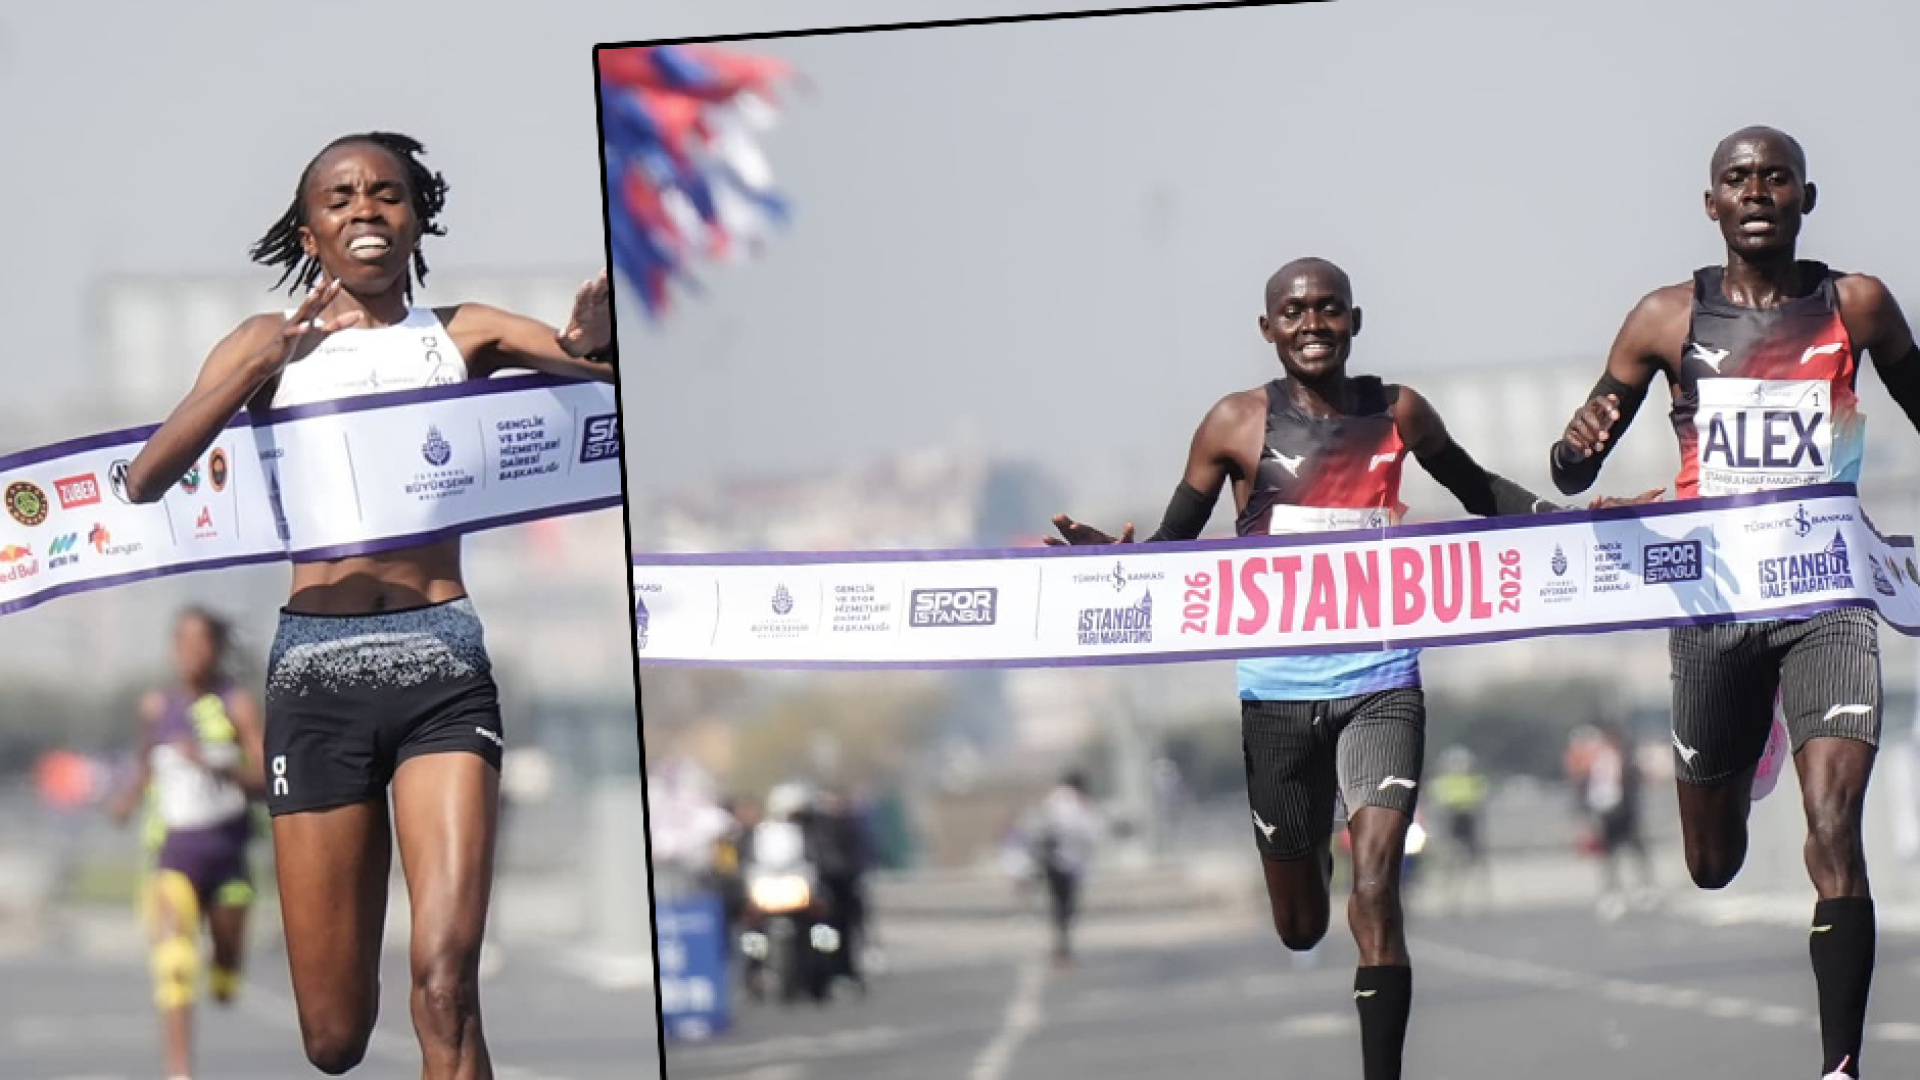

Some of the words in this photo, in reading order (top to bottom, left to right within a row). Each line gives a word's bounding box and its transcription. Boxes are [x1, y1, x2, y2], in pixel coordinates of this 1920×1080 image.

[1702, 411, 1825, 468] ALEX
[1499, 549, 1521, 613] 2026
[1647, 544, 1696, 567] SPOR
[916, 592, 992, 611] SPOR
[1181, 571, 1211, 634] 2026
[1215, 541, 1492, 636] ISTANBUL
[1761, 582, 1788, 598] HALF
